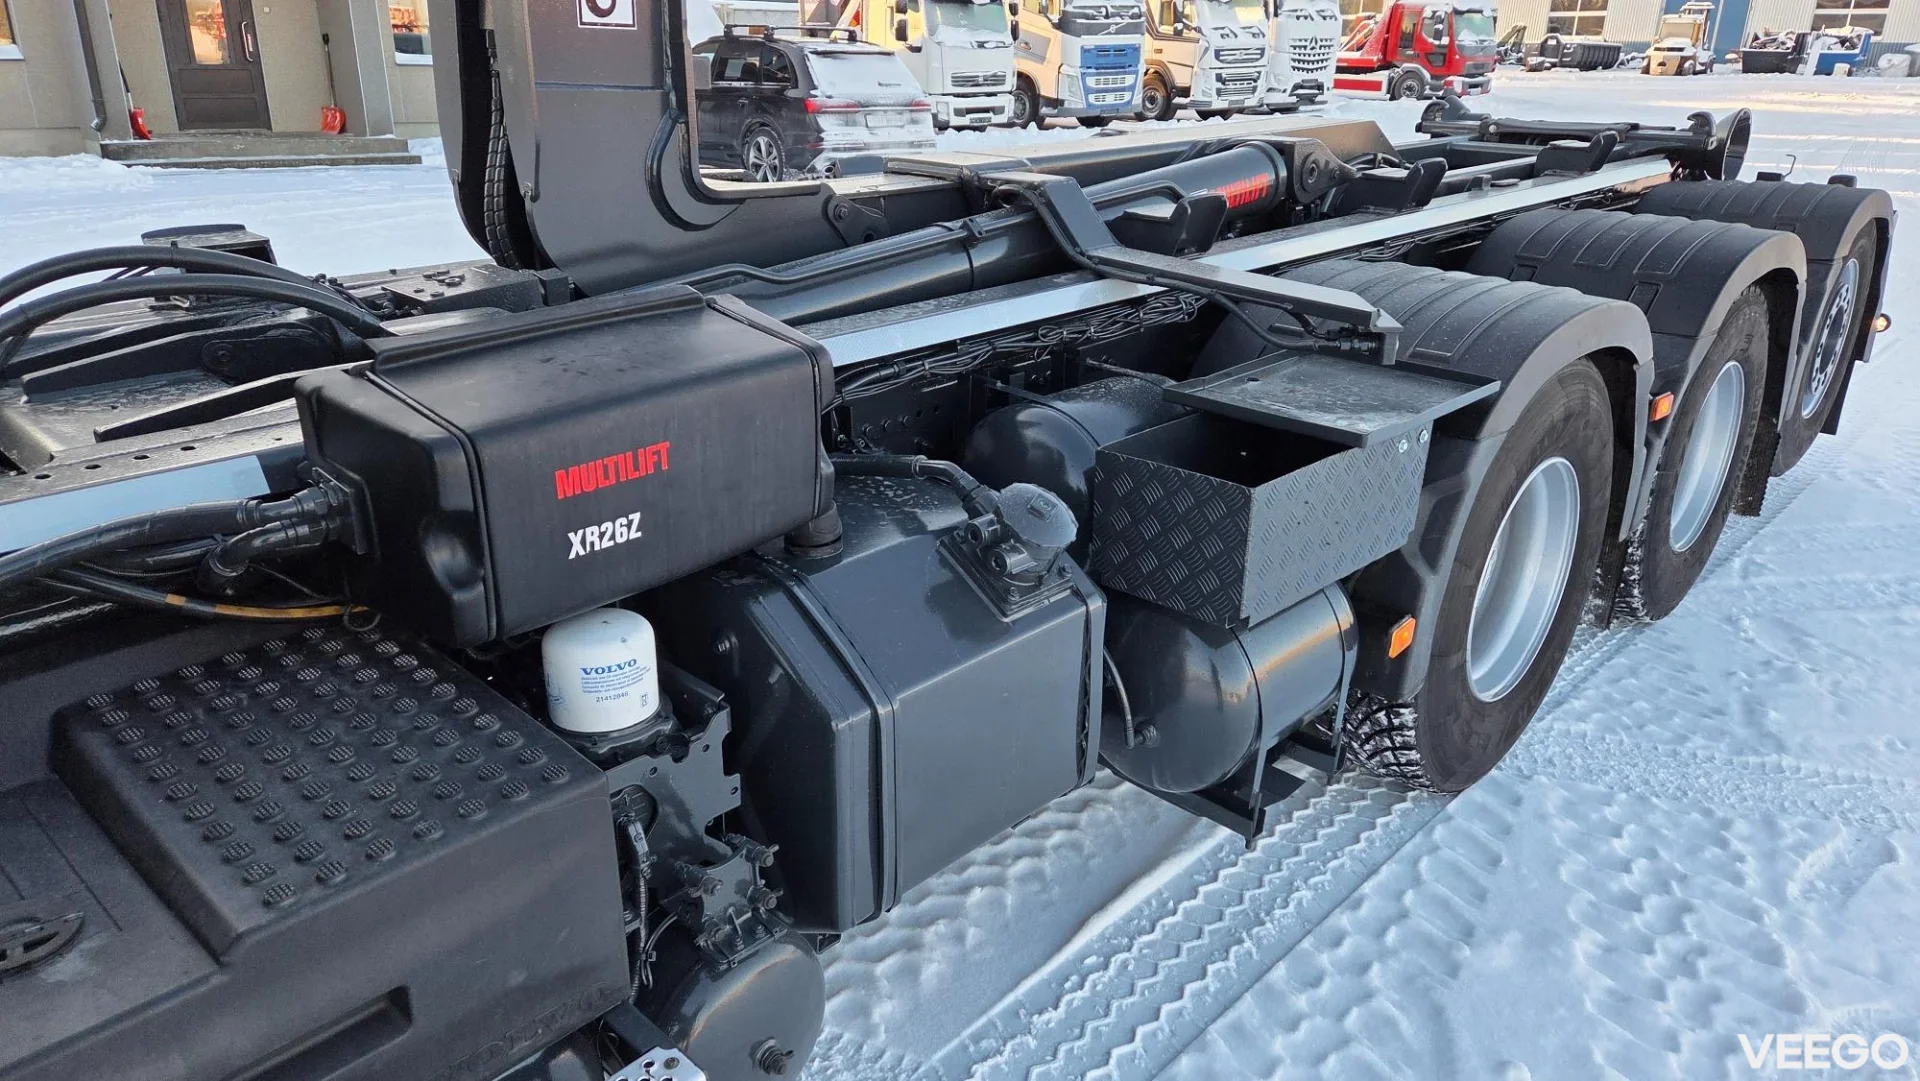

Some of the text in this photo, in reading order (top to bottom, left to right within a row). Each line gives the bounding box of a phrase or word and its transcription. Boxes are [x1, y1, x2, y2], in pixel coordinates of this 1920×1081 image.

[555, 441, 670, 500] MULTILIFT
[567, 511, 642, 560] XR26Z
[580, 658, 637, 675] VOLVO
